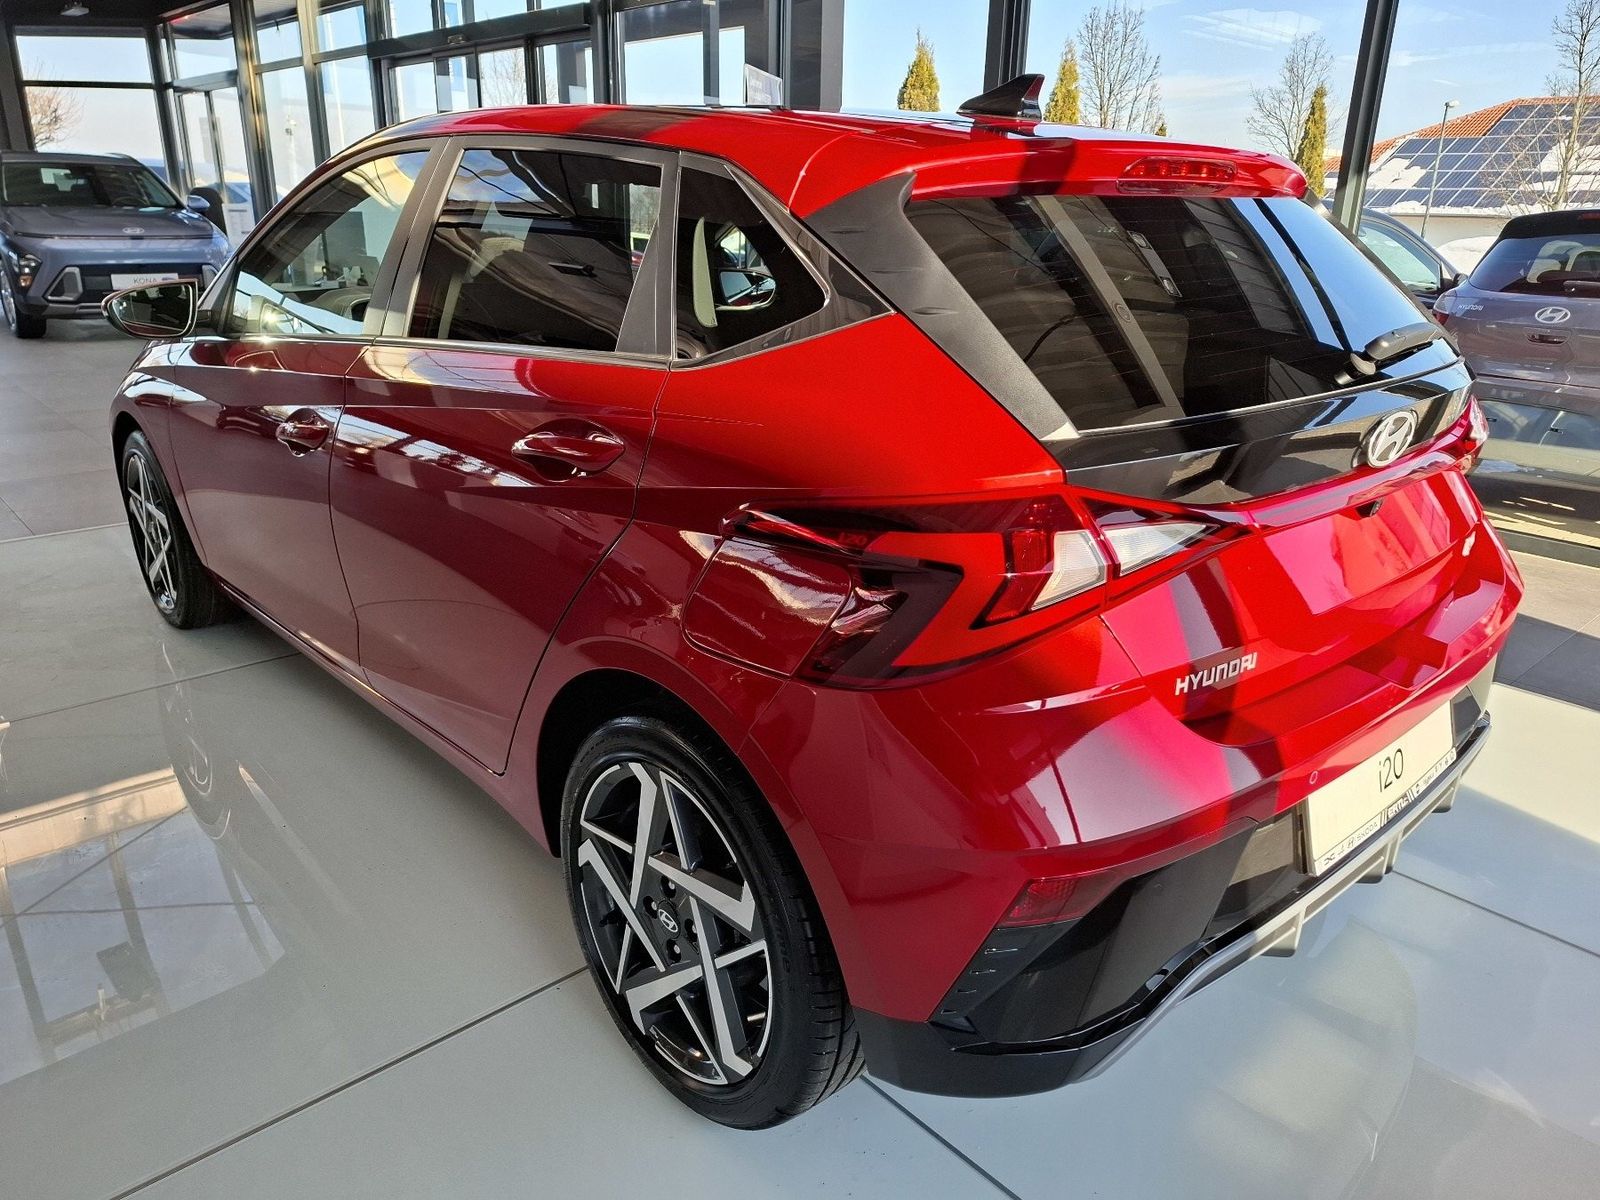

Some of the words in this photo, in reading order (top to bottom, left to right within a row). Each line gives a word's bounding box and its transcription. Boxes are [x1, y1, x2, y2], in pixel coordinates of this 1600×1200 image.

[133, 277, 158, 285] KONA
[1174, 651, 1258, 696] HYUNDAI
[1378, 748, 1404, 793] i20
